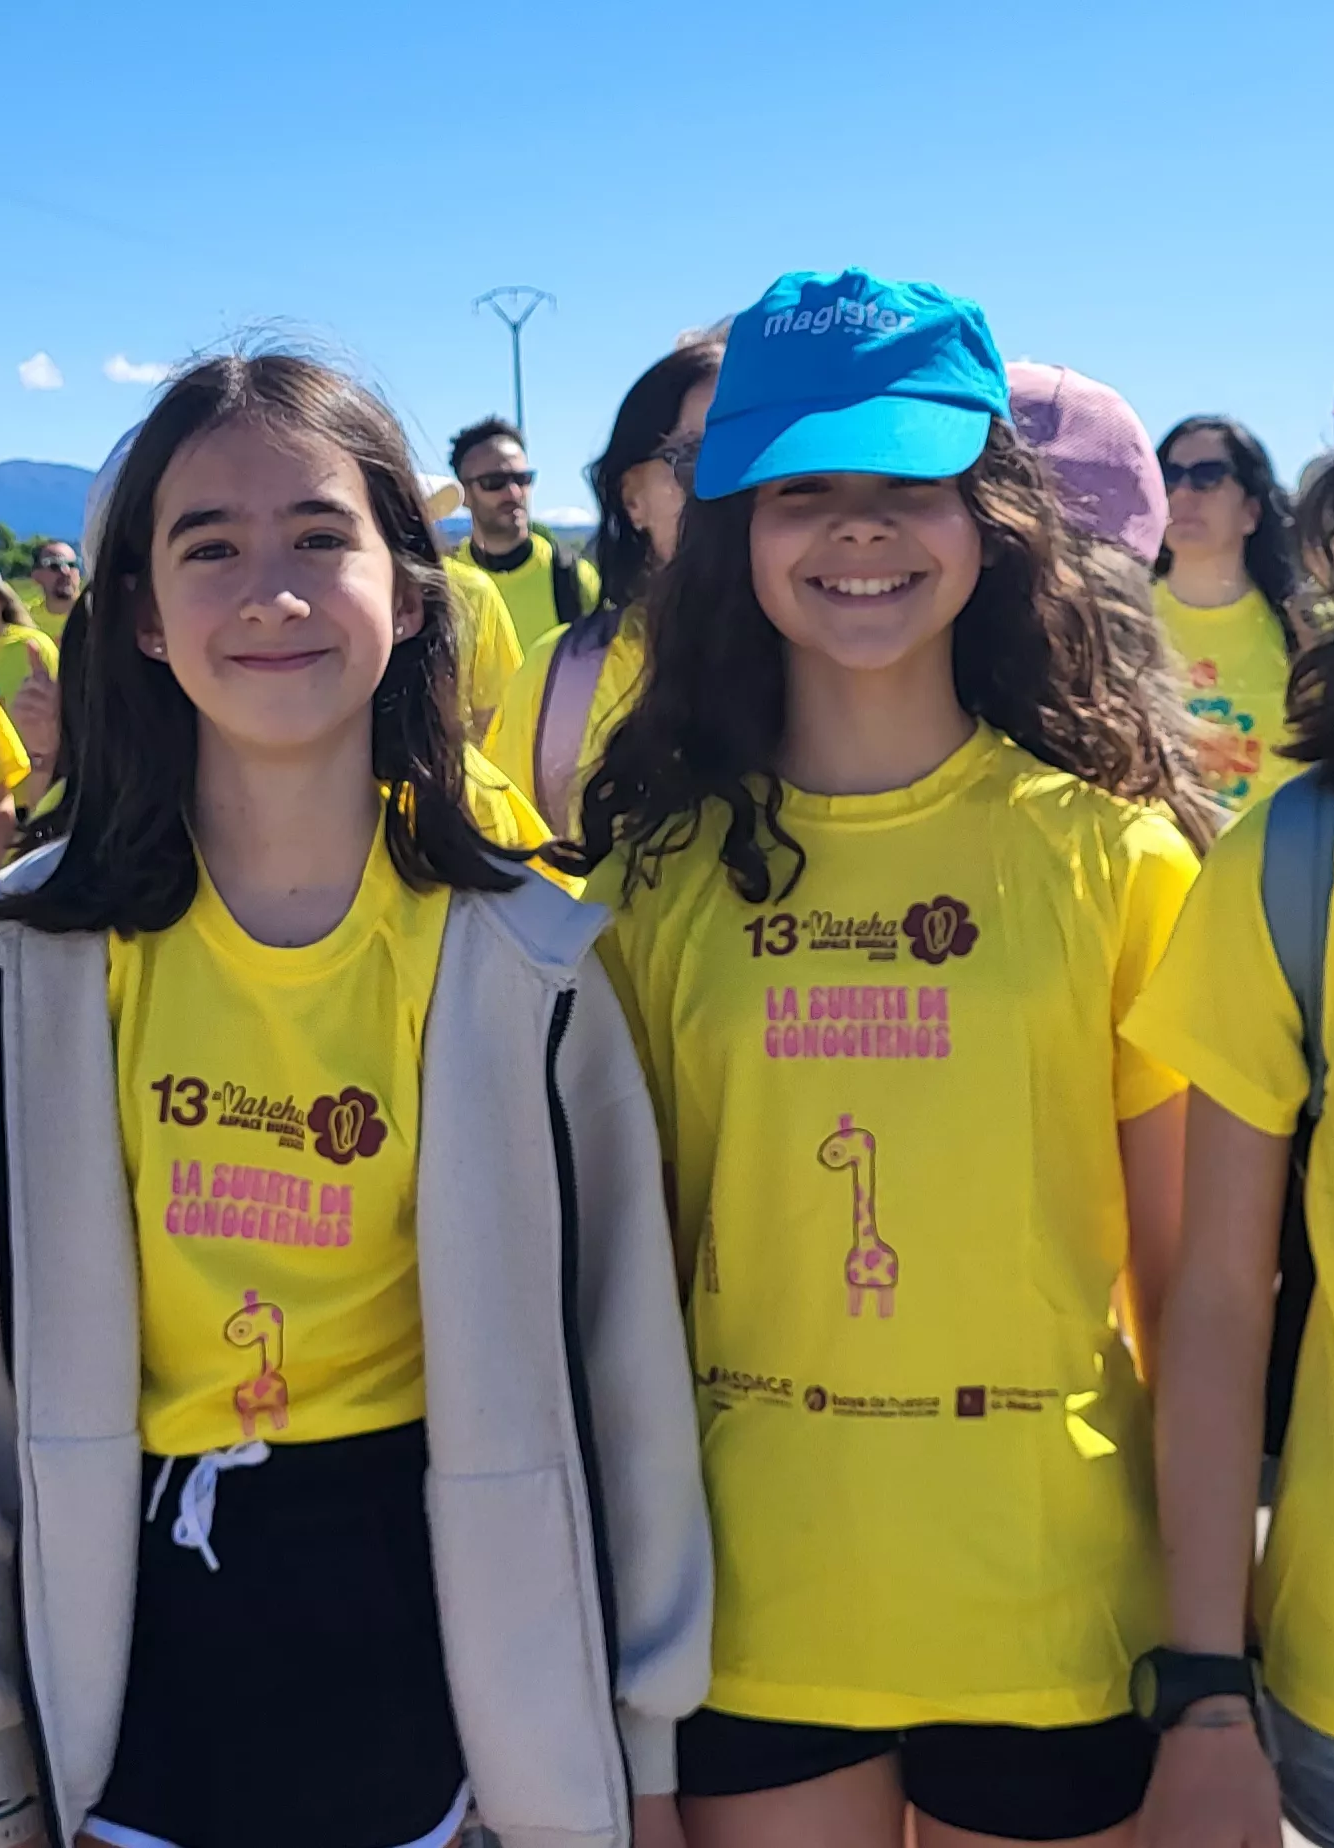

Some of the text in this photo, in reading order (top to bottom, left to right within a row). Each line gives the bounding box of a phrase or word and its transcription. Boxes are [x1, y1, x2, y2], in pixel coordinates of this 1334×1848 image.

[766, 986, 800, 1021] LA
[222, 1080, 305, 1126] Marcha
[171, 1159, 353, 1216] LA SUERTE DE
